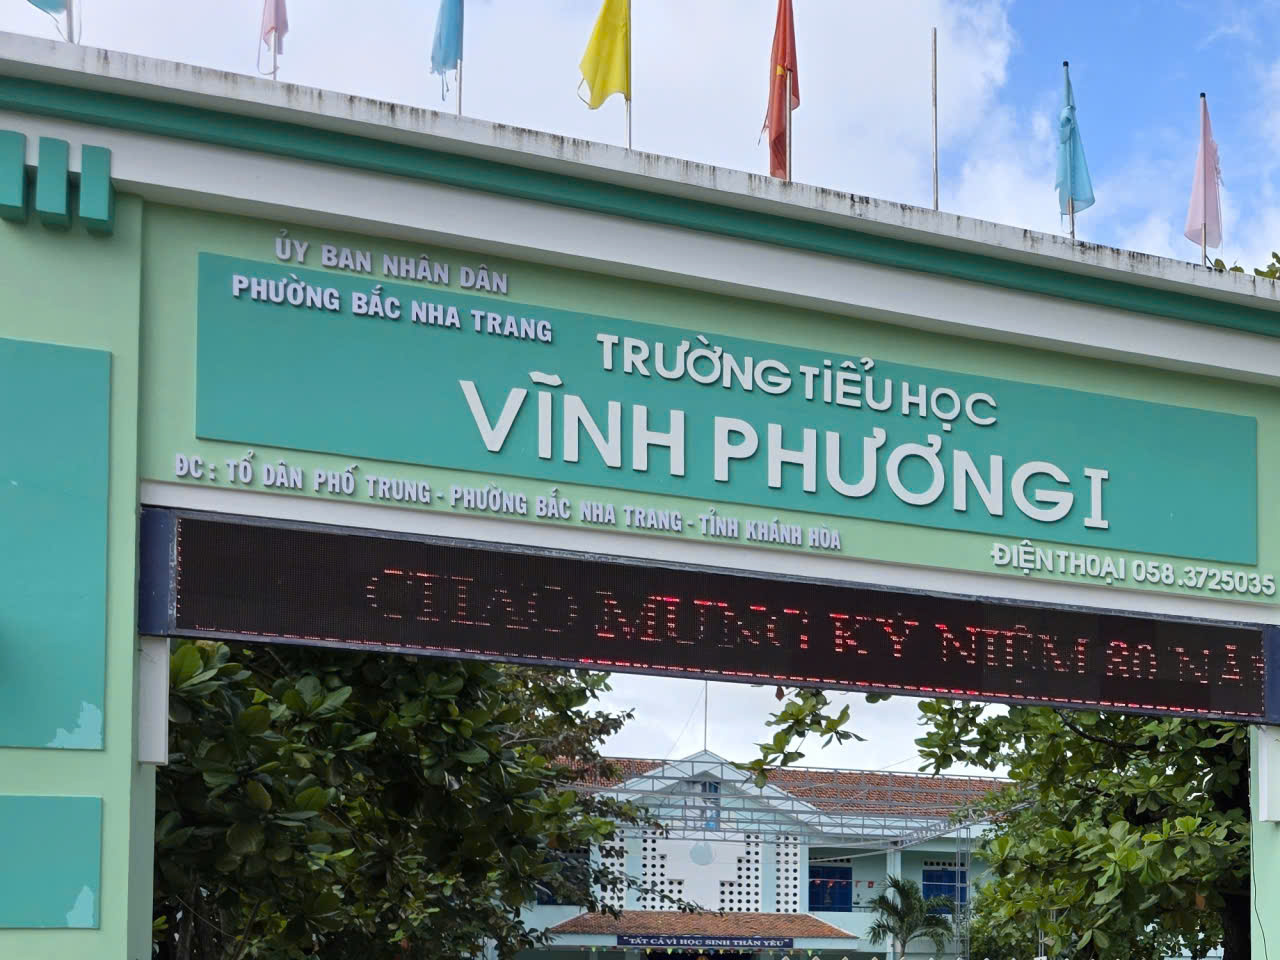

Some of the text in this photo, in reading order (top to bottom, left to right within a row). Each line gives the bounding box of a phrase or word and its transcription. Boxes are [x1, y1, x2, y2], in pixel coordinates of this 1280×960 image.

[275, 229, 508, 295] ỦY BAN NHÂN DÂN
[231, 273, 552, 343] PHƯỜNG BẮC NHA TRANG
[597, 333, 792, 395] TRƯỜNG
[901, 381, 998, 431] HỌC
[458, 370, 1111, 530] VĨNH PHƯƠNG I
[226, 450, 255, 484] TỔ
[263, 462, 303, 489] DÂN
[314, 464, 360, 495] PHỐ
[367, 476, 431, 504] TRUNG
[450, 482, 527, 515] PHƯỜNG
[535, 487, 571, 520] BẮC
[579, 501, 616, 525] NHA
[624, 505, 682, 532] TRANG
[699, 506, 739, 539] TỈNH
[746, 517, 802, 547] KHÁNH
[809, 523, 842, 550] HÒA
[990, 539, 1053, 574] ĐIỆN
[1056, 550, 1126, 584] THOẠI
[680, 938, 702, 946] HỌC
